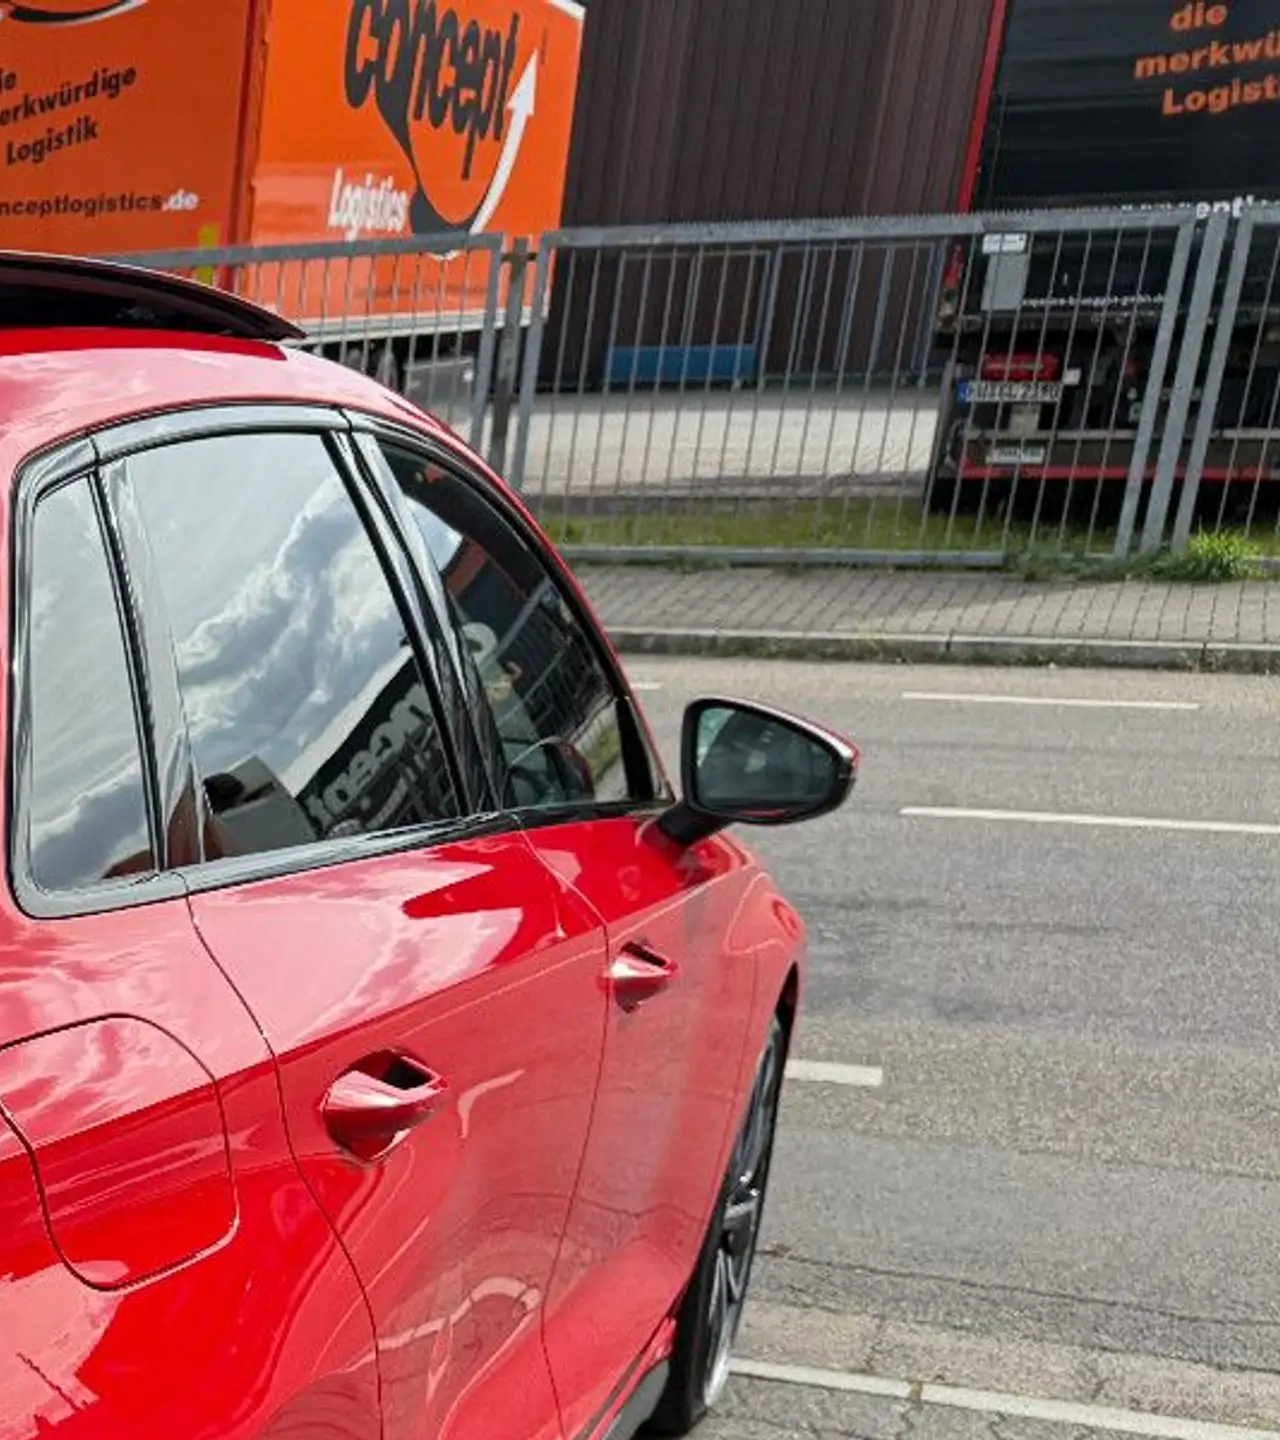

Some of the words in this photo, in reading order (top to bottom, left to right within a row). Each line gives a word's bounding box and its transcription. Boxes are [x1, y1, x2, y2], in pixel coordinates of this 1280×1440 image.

[1169, 1, 1228, 32] die
[5, 116, 100, 165] Logistik
[328, 167, 408, 243] Logistics
